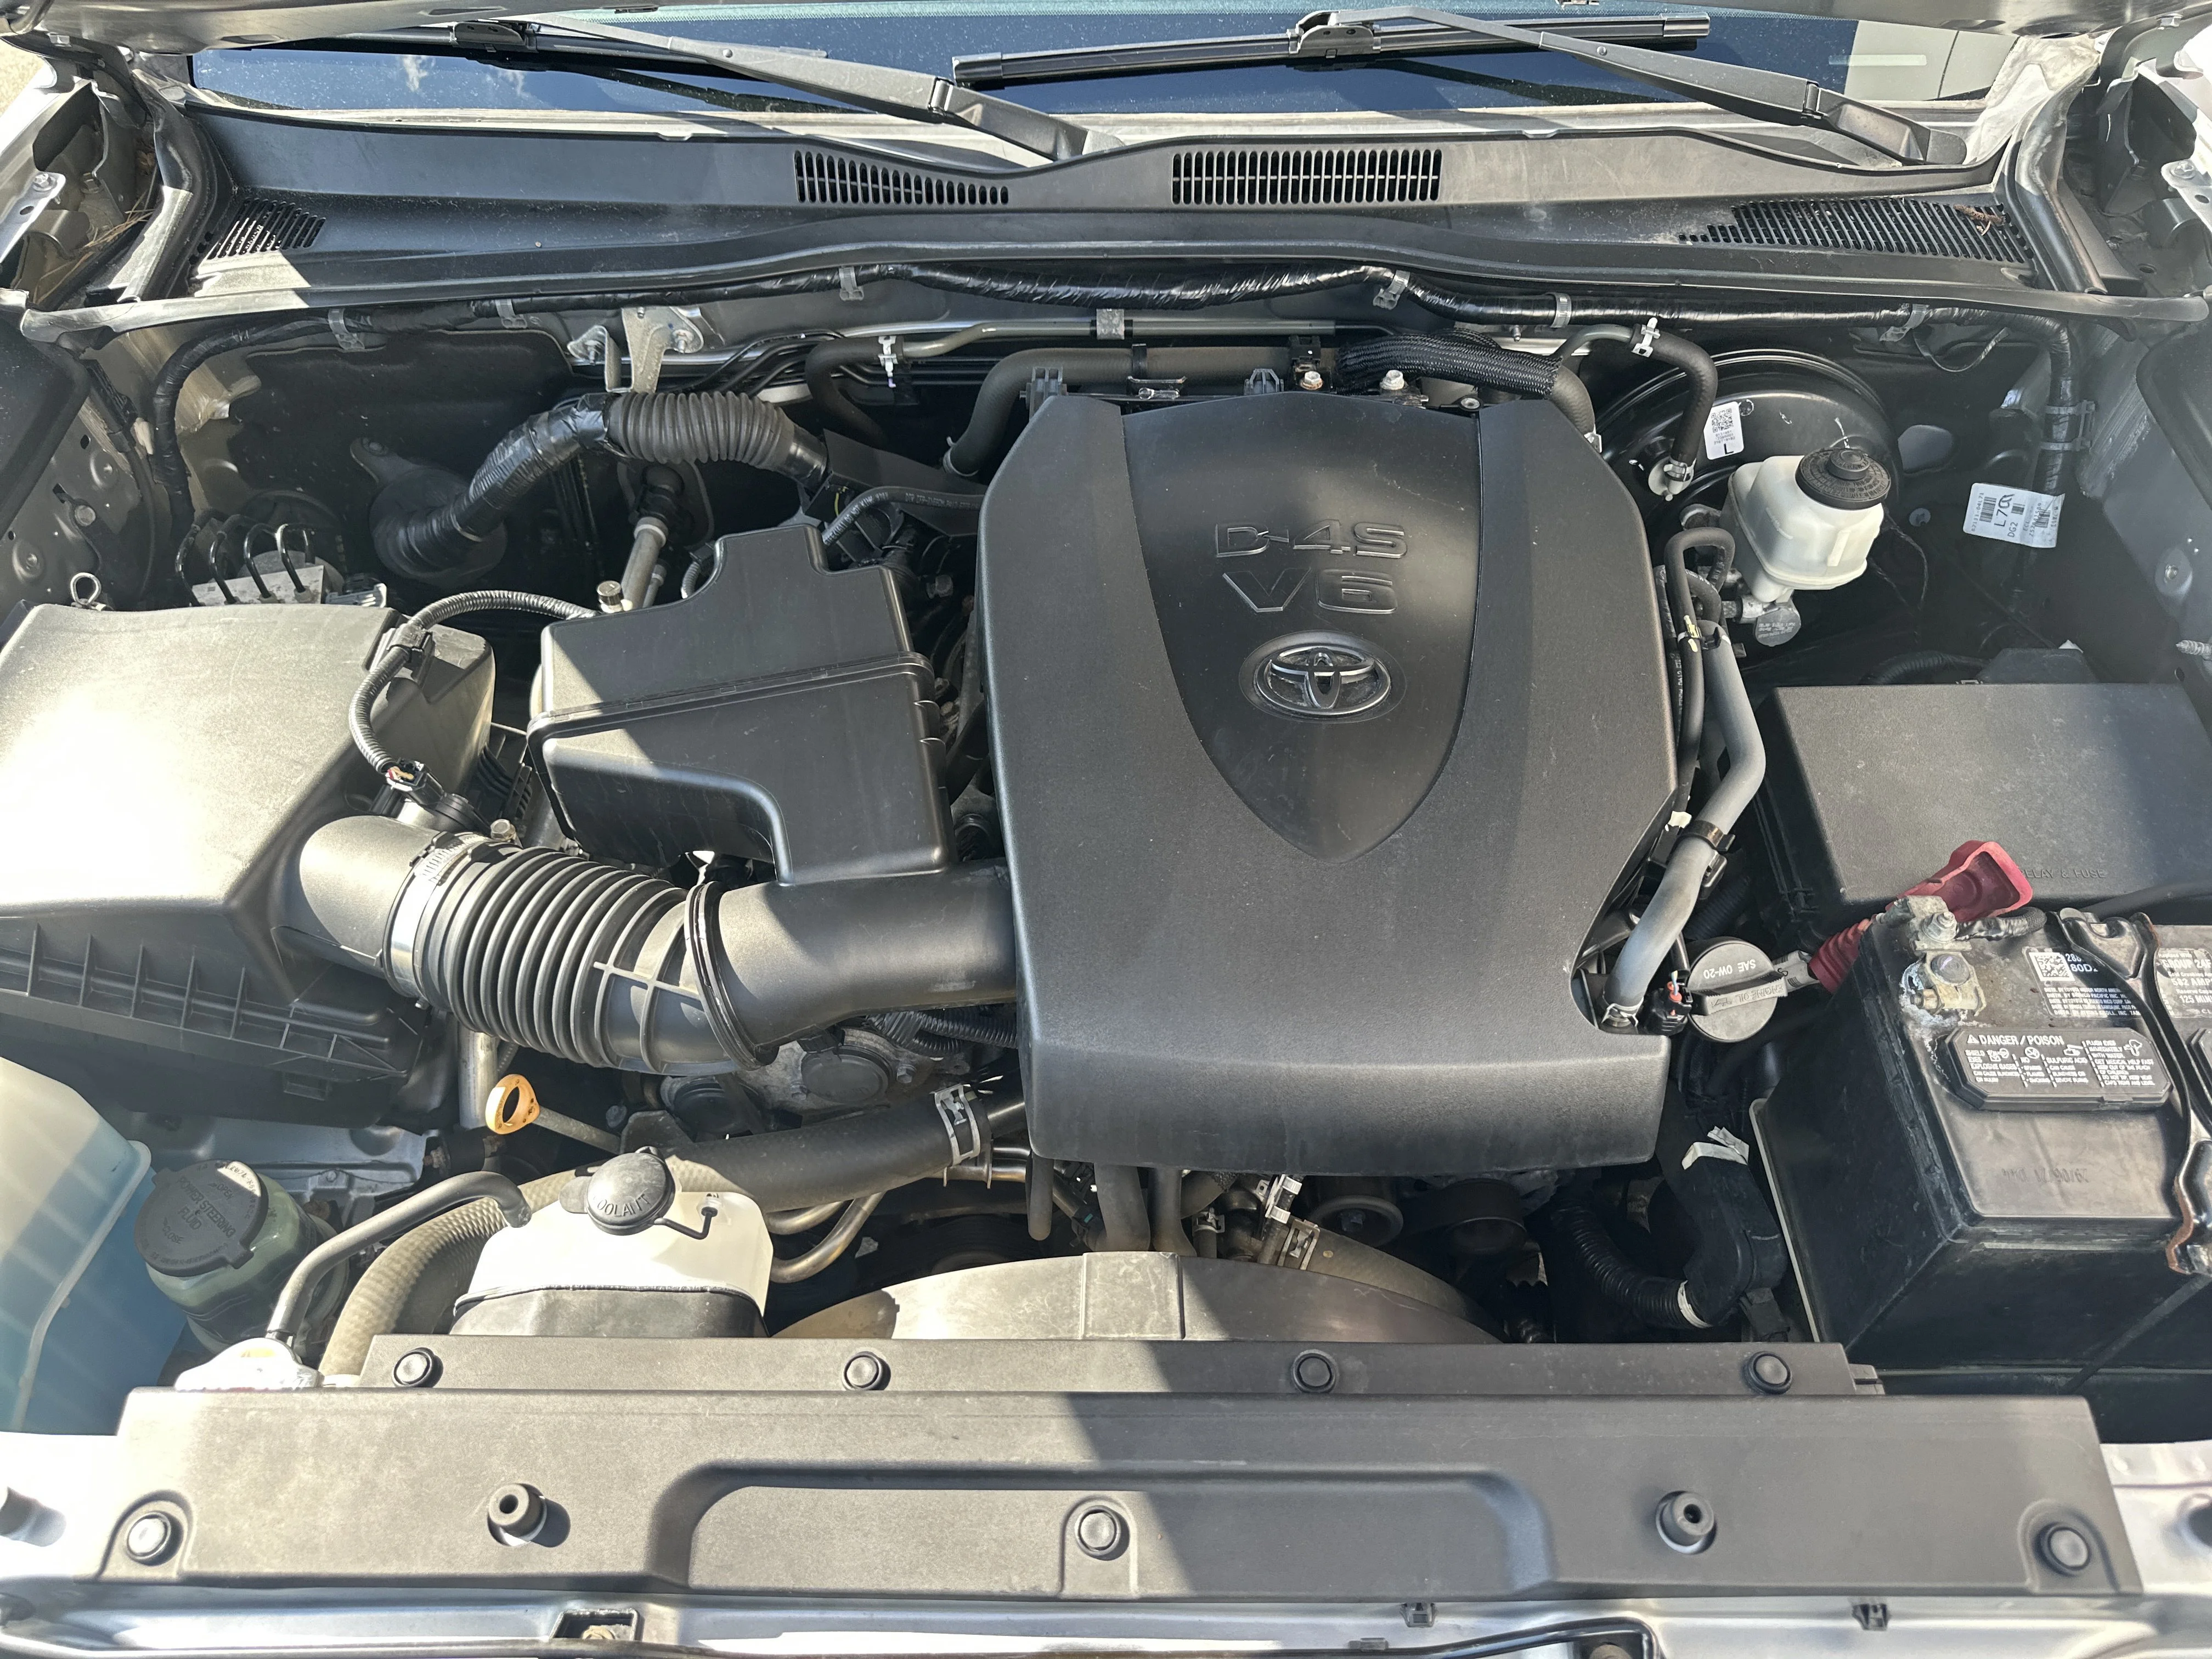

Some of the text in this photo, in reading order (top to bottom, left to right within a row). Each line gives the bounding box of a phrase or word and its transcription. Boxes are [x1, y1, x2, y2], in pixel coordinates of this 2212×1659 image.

[1724, 443, 1734, 454] L
[1215, 519, 1408, 558] D-4S
[2007, 522, 2018, 538] DG2
[1222, 567, 1398, 614] V6
[2022, 869, 2108, 878] ELAY & FUSE
[1703, 959, 1756, 979] SAE 0W-20
[2162, 959, 2192, 968] GROUP
[1736, 984, 1784, 1002] ENGINE OIL
[2179, 995, 2194, 1003] 125
[1978, 1035, 2019, 1045] DANGER
[2026, 1035, 2064, 1045] POISON
[216, 1183, 234, 1200] OPEN
[177, 1176, 205, 1204] POWER
[200, 1200, 236, 1238] STEERING
[594, 1194, 651, 1217] OOLANT
[178, 1205, 202, 1231] FLUID
[162, 1226, 184, 1244] CLOSE
